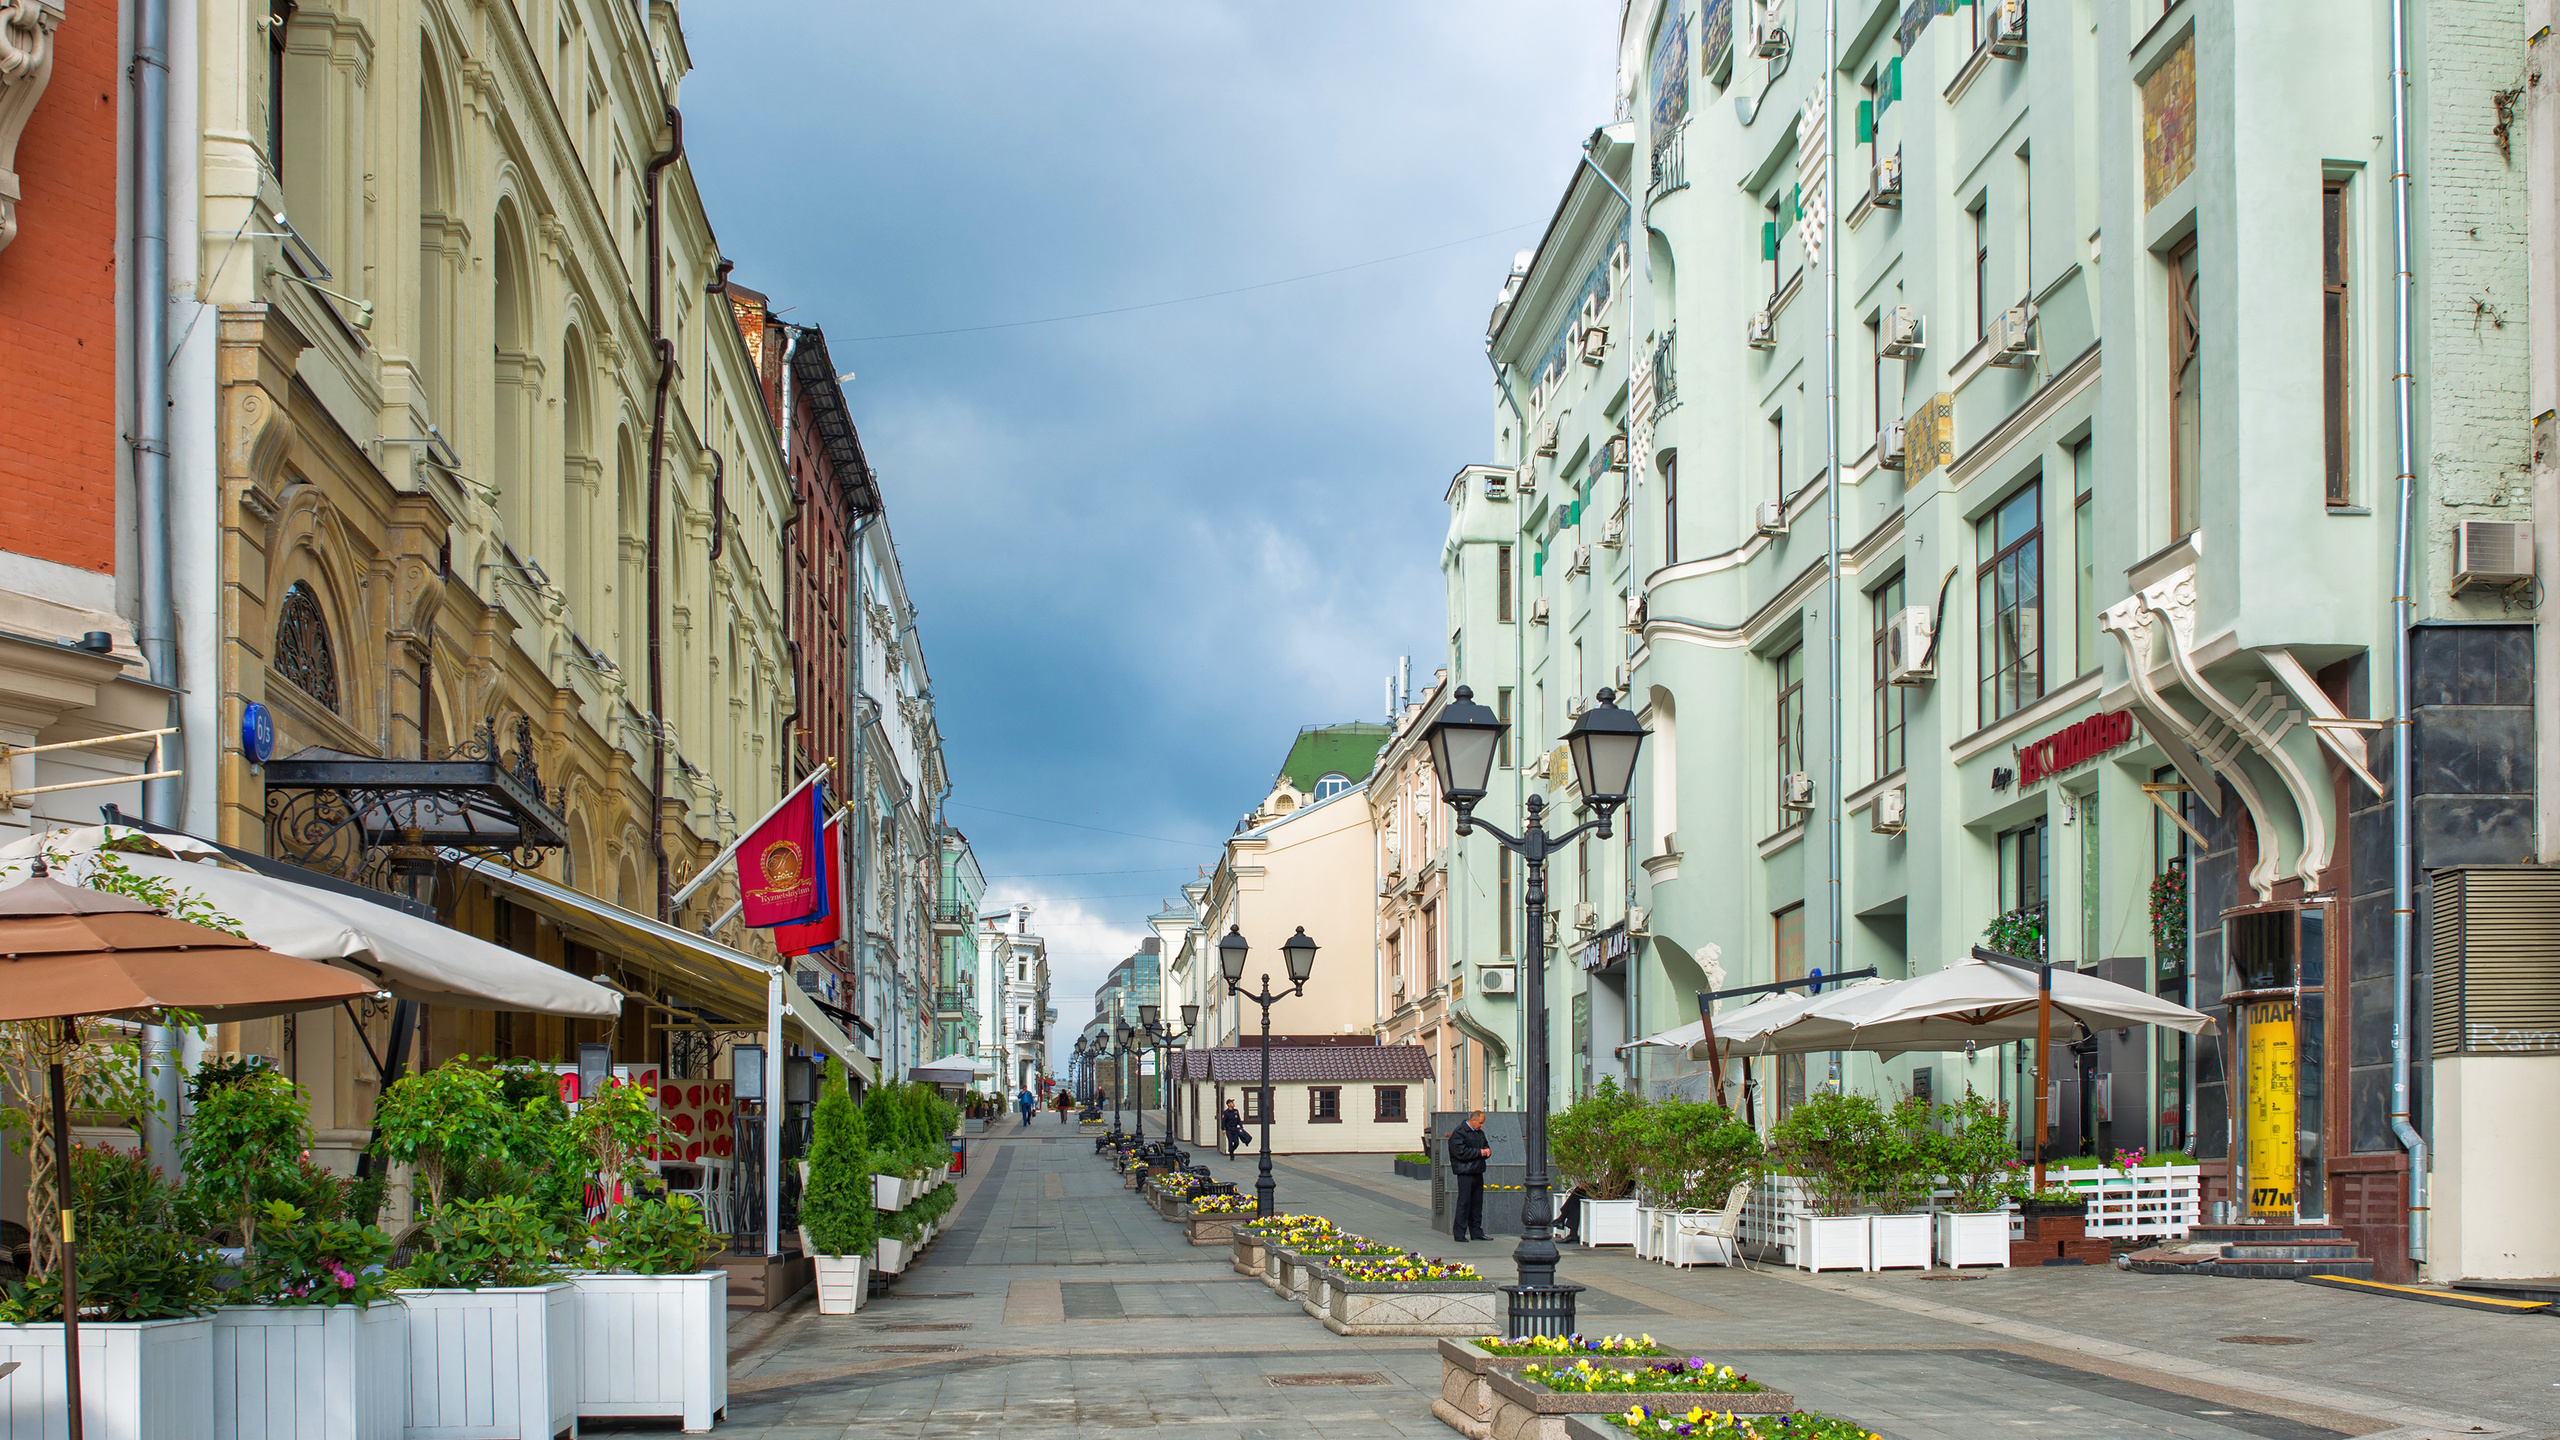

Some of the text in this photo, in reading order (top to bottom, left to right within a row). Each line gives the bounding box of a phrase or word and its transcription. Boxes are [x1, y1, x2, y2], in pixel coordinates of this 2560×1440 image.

[257, 715, 271, 744] 6/3
[1991, 767, 2012, 790] Кафе
[1581, 942, 1600, 970] КОФЕ
[2162, 957, 2176, 973] Кафе
[2251, 1188, 2279, 1207] 477
